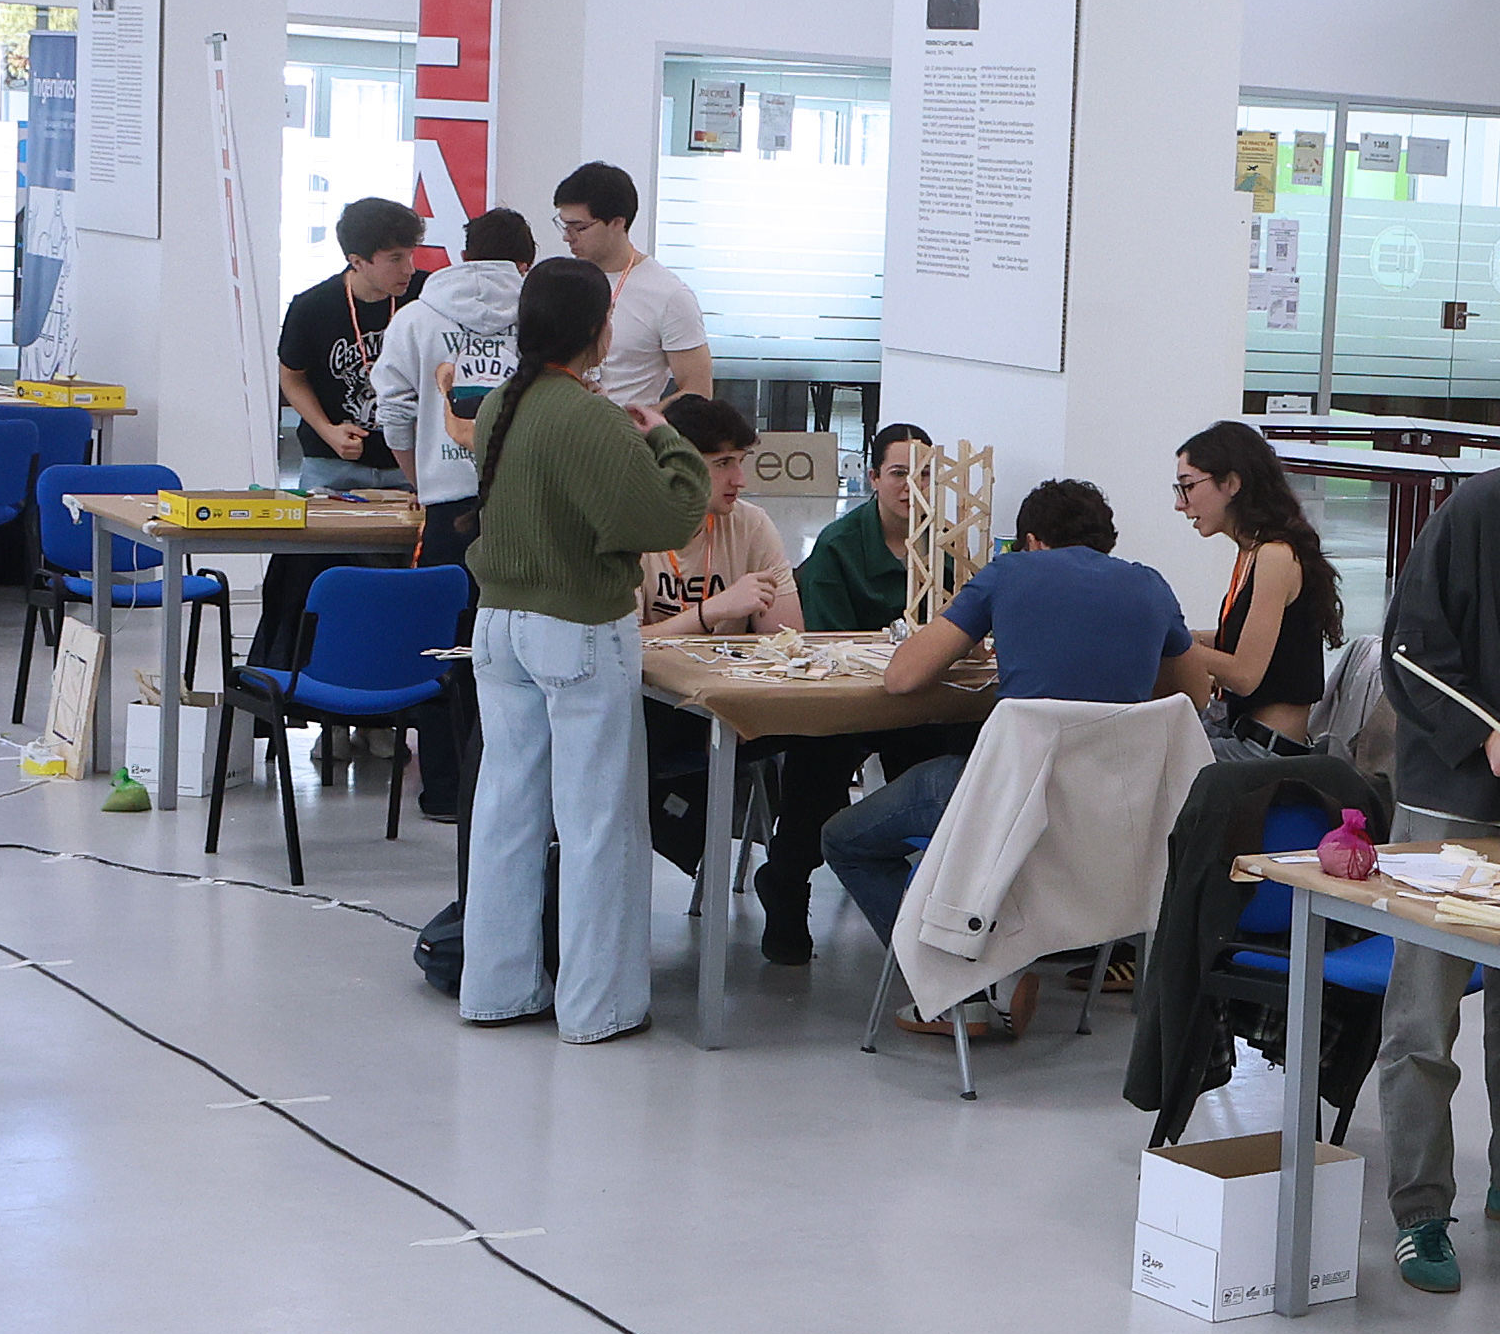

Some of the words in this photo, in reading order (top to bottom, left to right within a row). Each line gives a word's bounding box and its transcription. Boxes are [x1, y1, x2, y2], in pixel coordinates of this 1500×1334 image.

[441, 331, 506, 359] Wiser
[460, 359, 515, 380] NUDE
[745, 449, 815, 482] ea
